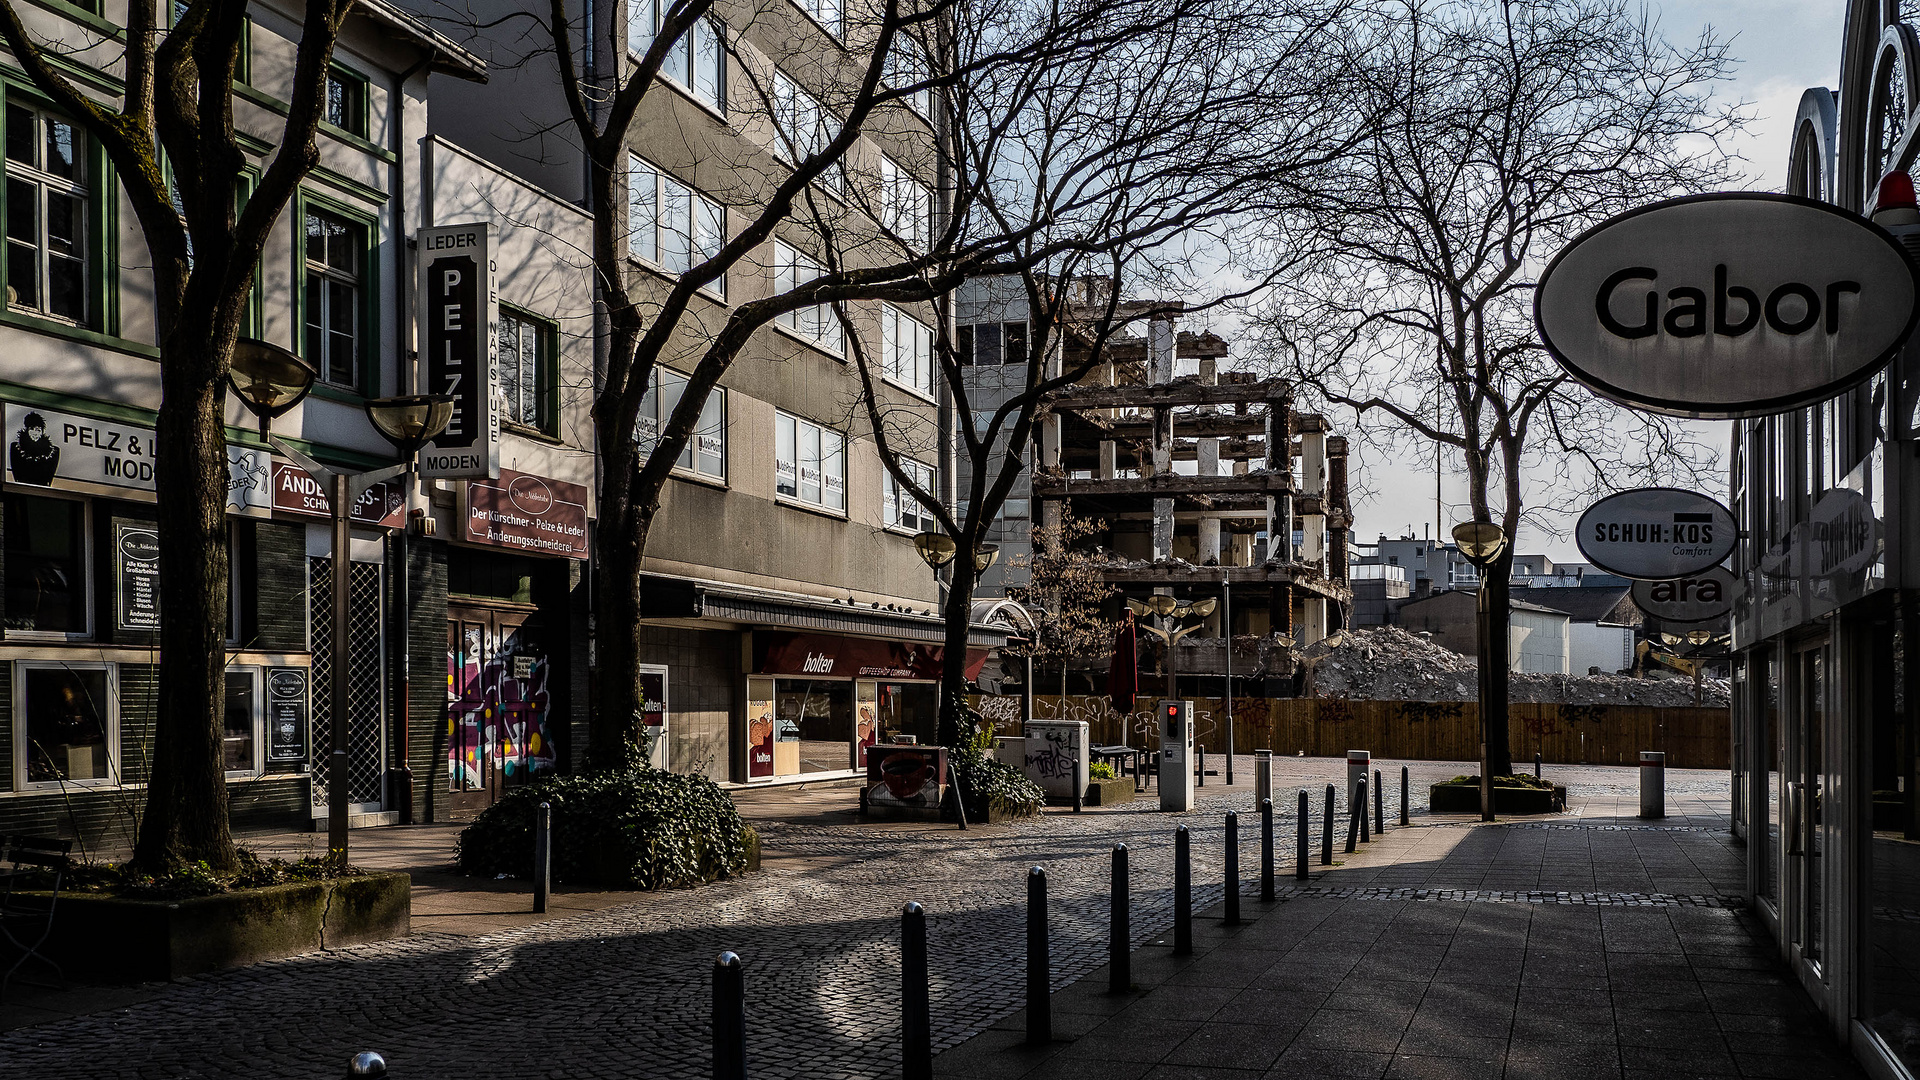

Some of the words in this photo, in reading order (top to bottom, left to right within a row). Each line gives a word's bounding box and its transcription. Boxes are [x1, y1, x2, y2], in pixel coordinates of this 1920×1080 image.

[427, 233, 477, 250] LEDER
[489, 259, 497, 304] DIE
[1595, 263, 1861, 339] Gabor
[444, 269, 463, 435] PELZE
[489, 321, 498, 443] NÄHSTUBE
[63, 423, 121, 452] PELZ
[127, 436, 143, 456] &
[703, 437, 721, 452] JobPoin
[104, 456, 154, 481] MOD
[427, 455, 480, 470] MODEN
[472, 507, 487, 520] Der
[488, 510, 529, 527] Kürschner
[536, 518, 556, 532] Pelze
[556, 523, 563, 533] &
[564, 523, 585, 537] Leder
[1595, 523, 1713, 543] SCHUH:KOS
[487, 525, 572, 552] Änderungsschneiderei
[1672, 546, 1713, 557] Comfort
[1650, 579, 1723, 602] ara
[803, 652, 834, 673] bolten
[859, 667, 890, 676] COFFEESHOP
[890, 669, 911, 677] COMPANY
[644, 698, 662, 712] olten
[756, 752, 771, 763] bolten
